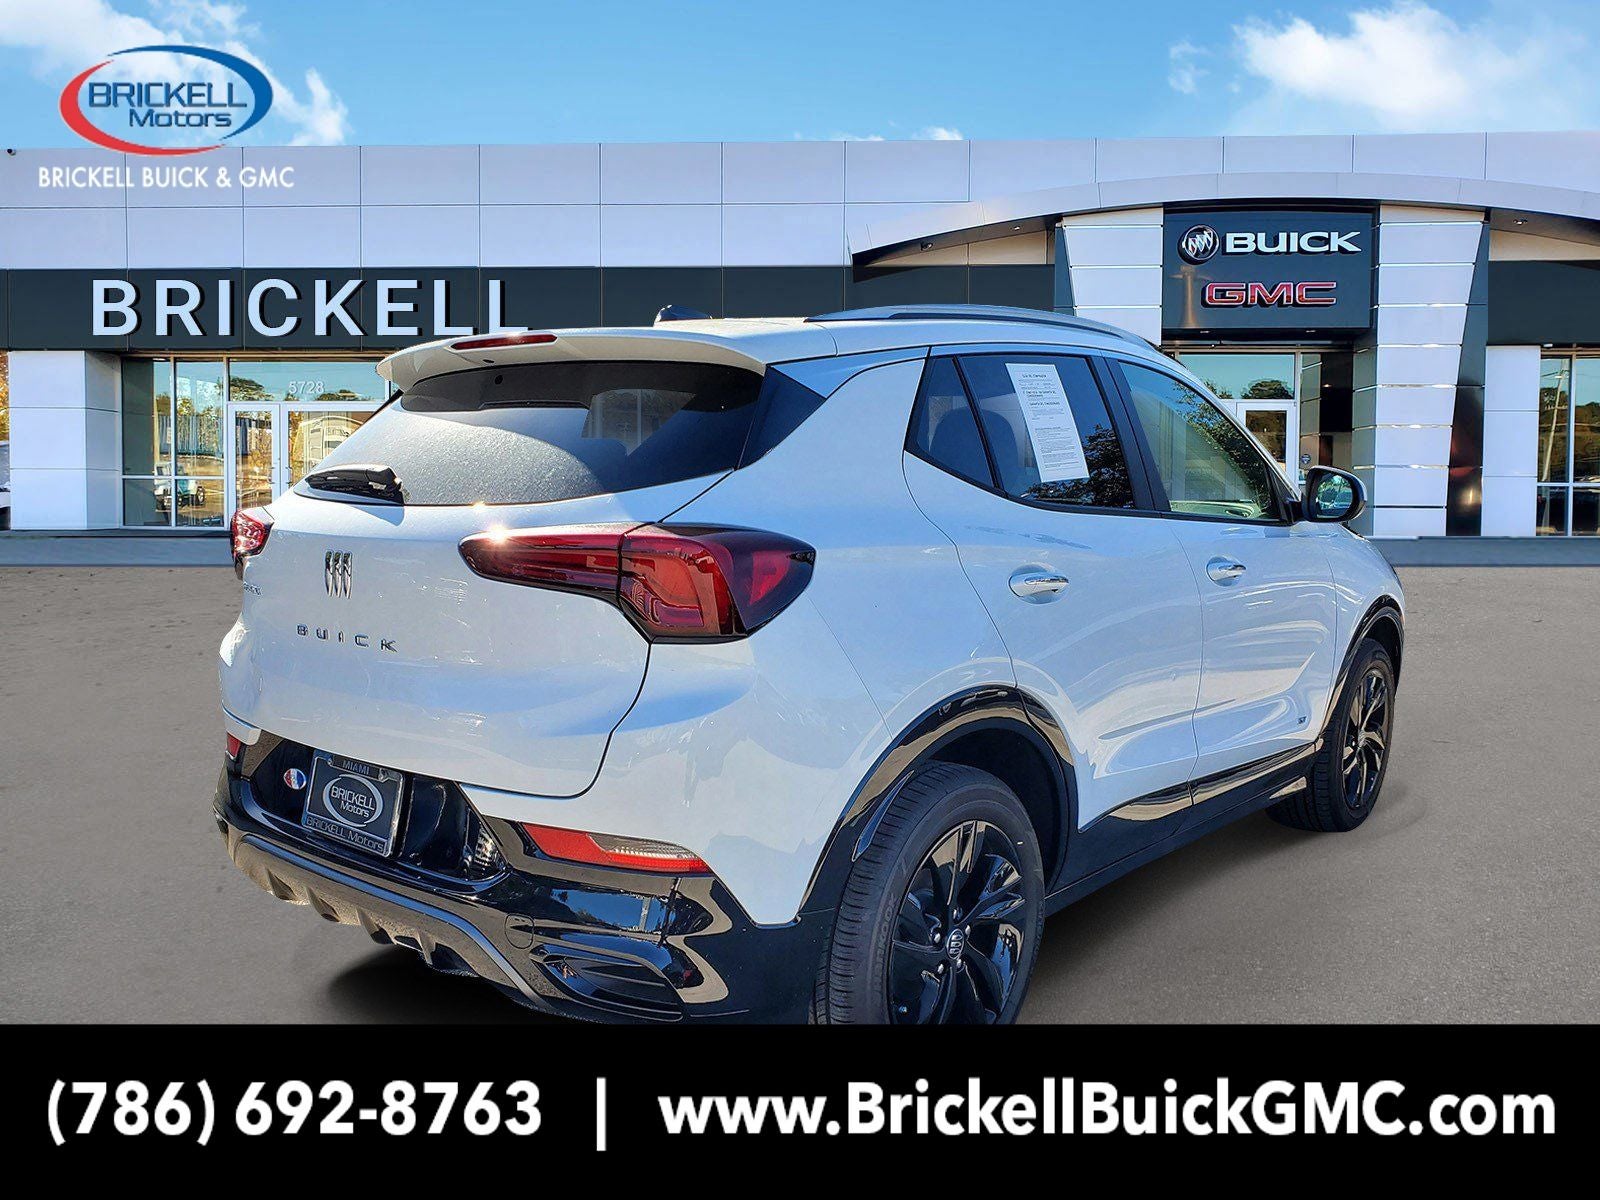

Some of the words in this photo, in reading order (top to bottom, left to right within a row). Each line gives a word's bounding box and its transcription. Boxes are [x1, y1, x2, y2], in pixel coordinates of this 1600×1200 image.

[1225, 231, 1362, 253] BUICK
[1205, 282, 1337, 305] GMC
[91, 278, 530, 337] BRICKELL
[289, 380, 325, 394] 5728
[296, 624, 397, 652] BUICK
[342, 760, 370, 775] MIAMI
[331, 785, 375, 811] BRICKELL
[340, 801, 370, 818] Motors
[306, 816, 346, 838] BRICKELL
[347, 830, 384, 852] Motors
